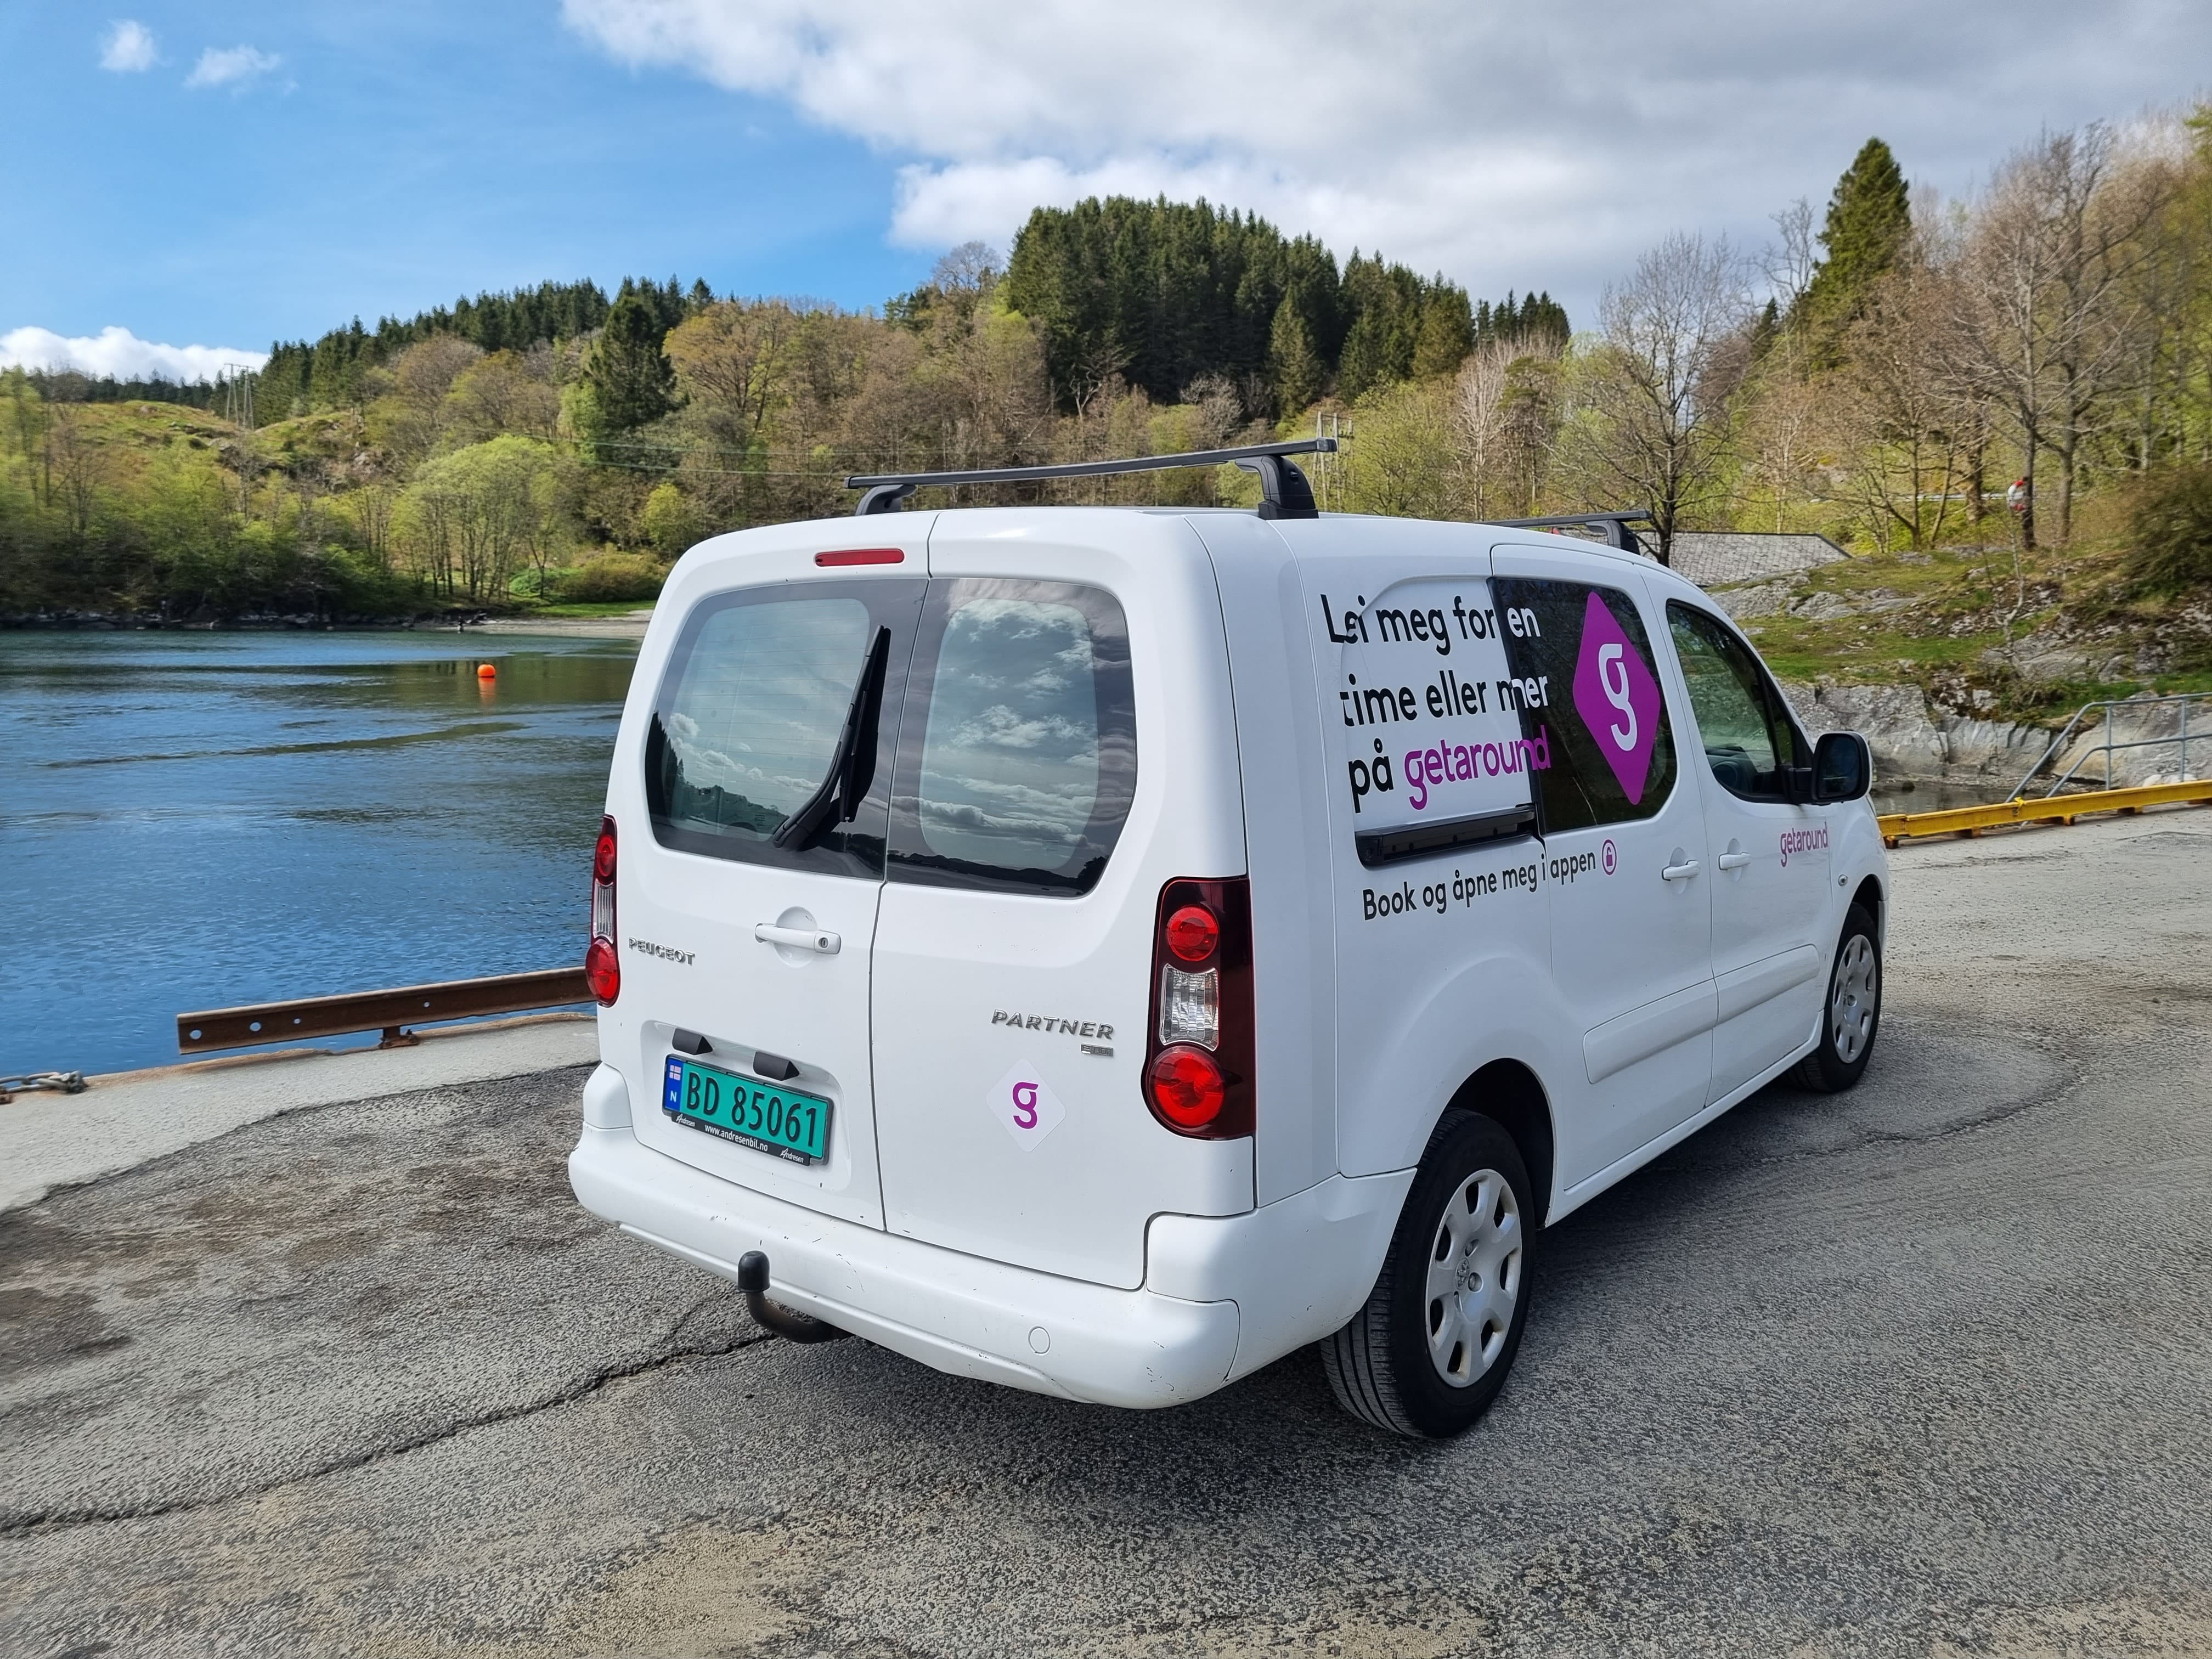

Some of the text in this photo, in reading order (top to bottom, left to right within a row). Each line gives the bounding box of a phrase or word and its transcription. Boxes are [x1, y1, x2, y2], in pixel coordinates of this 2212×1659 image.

[1321, 594, 1541, 656] Lei meg for en
[1426, 670, 1487, 719] eller
[1496, 675, 1548, 712] mer
[1598, 643, 1638, 752] g
[1348, 725, 1551, 814] på getaround
[1780, 821, 1829, 867] getaround
[1362, 851, 1596, 921] Book og åpne meg i appen
[629, 937, 695, 966] PEUGEOT
[991, 1009, 1114, 1040] PARTNER
[670, 1090, 677, 1103] N
[686, 1071, 817, 1148] BD 85061
[1012, 1081, 1039, 1130] g
[704, 1124, 768, 1152] www.andresenbil.no
[780, 1148, 804, 1164] Andresen
